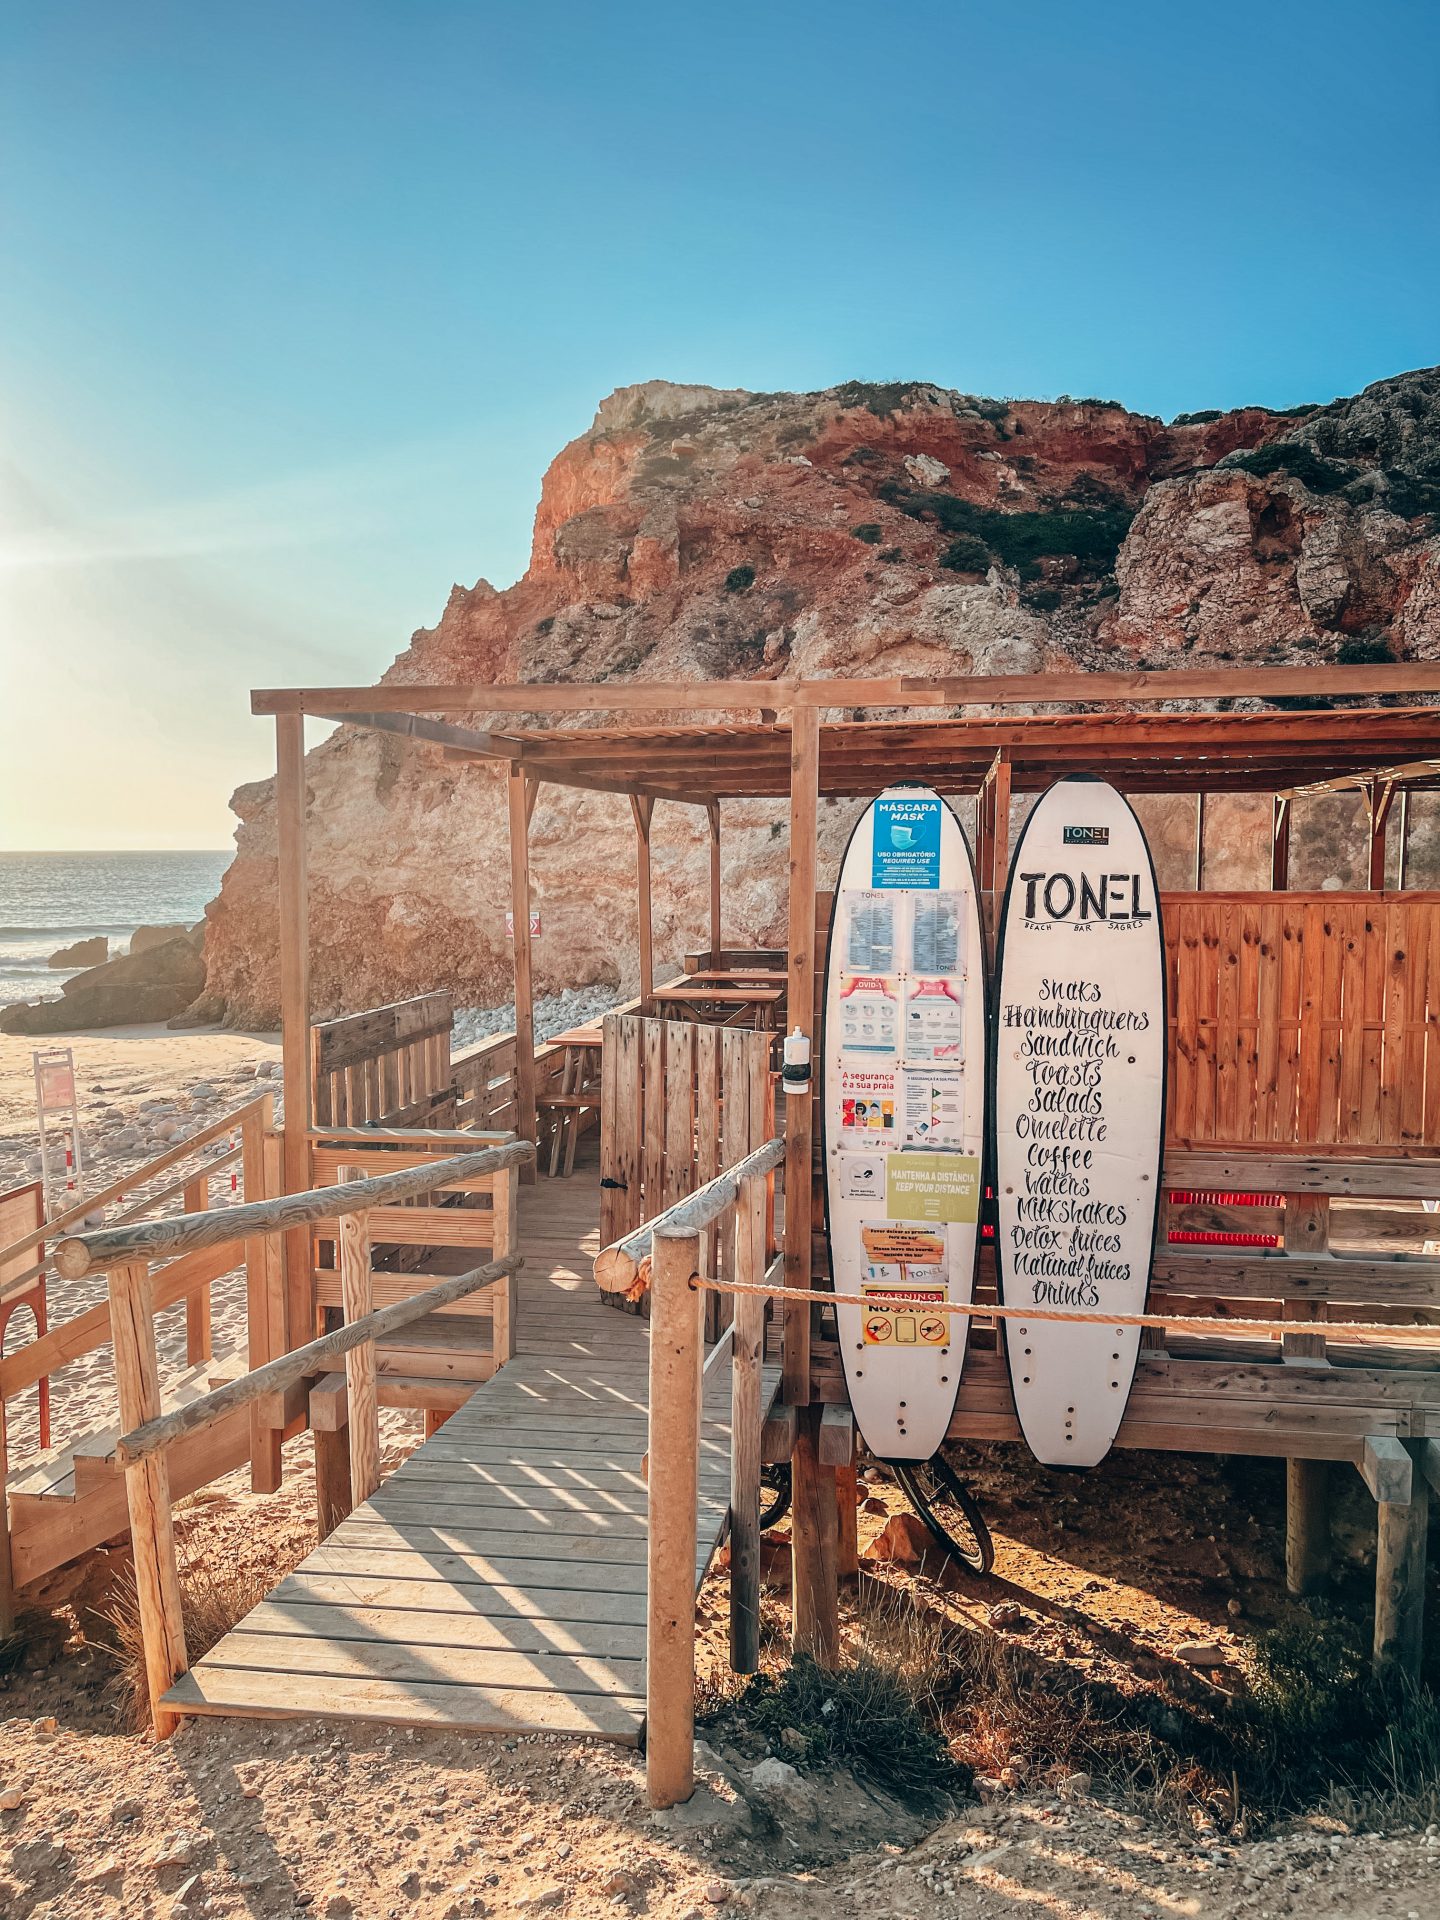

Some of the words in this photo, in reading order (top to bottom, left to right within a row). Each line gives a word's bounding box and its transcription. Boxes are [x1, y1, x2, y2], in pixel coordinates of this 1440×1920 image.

[880, 802, 937, 812] MÁSCARA
[891, 813, 925, 821] MASK
[1065, 827, 1108, 838] TONEL
[1020, 872, 1152, 920] TONEL
[1025, 921, 1052, 931] BEACH
[1073, 924, 1092, 932] BAR
[1108, 921, 1143, 931] SAGRES
[1039, 978, 1101, 1002] Snaks
[1021, 1030, 1120, 1058] Sandwich
[842, 1080, 847, 1088] é
[873, 1081, 894, 1090] praia
[850, 1073, 894, 1082] segurança
[1029, 1086, 1102, 1115] Salads
[1016, 1113, 1108, 1141] Omelette
[1027, 1143, 1093, 1175] Coffee
[891, 1169, 930, 1181] MANTENHA
[931, 1172, 937, 1181] A
[937, 1171, 975, 1183] DISTÂNCIA
[1024, 1169, 1090, 1197] Waters
[896, 1182, 914, 1192] KEEP
[914, 1183, 934, 1193] YOUR
[935, 1184, 971, 1195] DISTANCE
[1017, 1196, 1127, 1225] Milkshakes
[1011, 1225, 1062, 1250] Detox
[909, 1267, 943, 1278] TONEL
[1013, 1252, 1085, 1276] Natural
[875, 1292, 937, 1300] WARNING
[1032, 1279, 1100, 1306] Drinks
